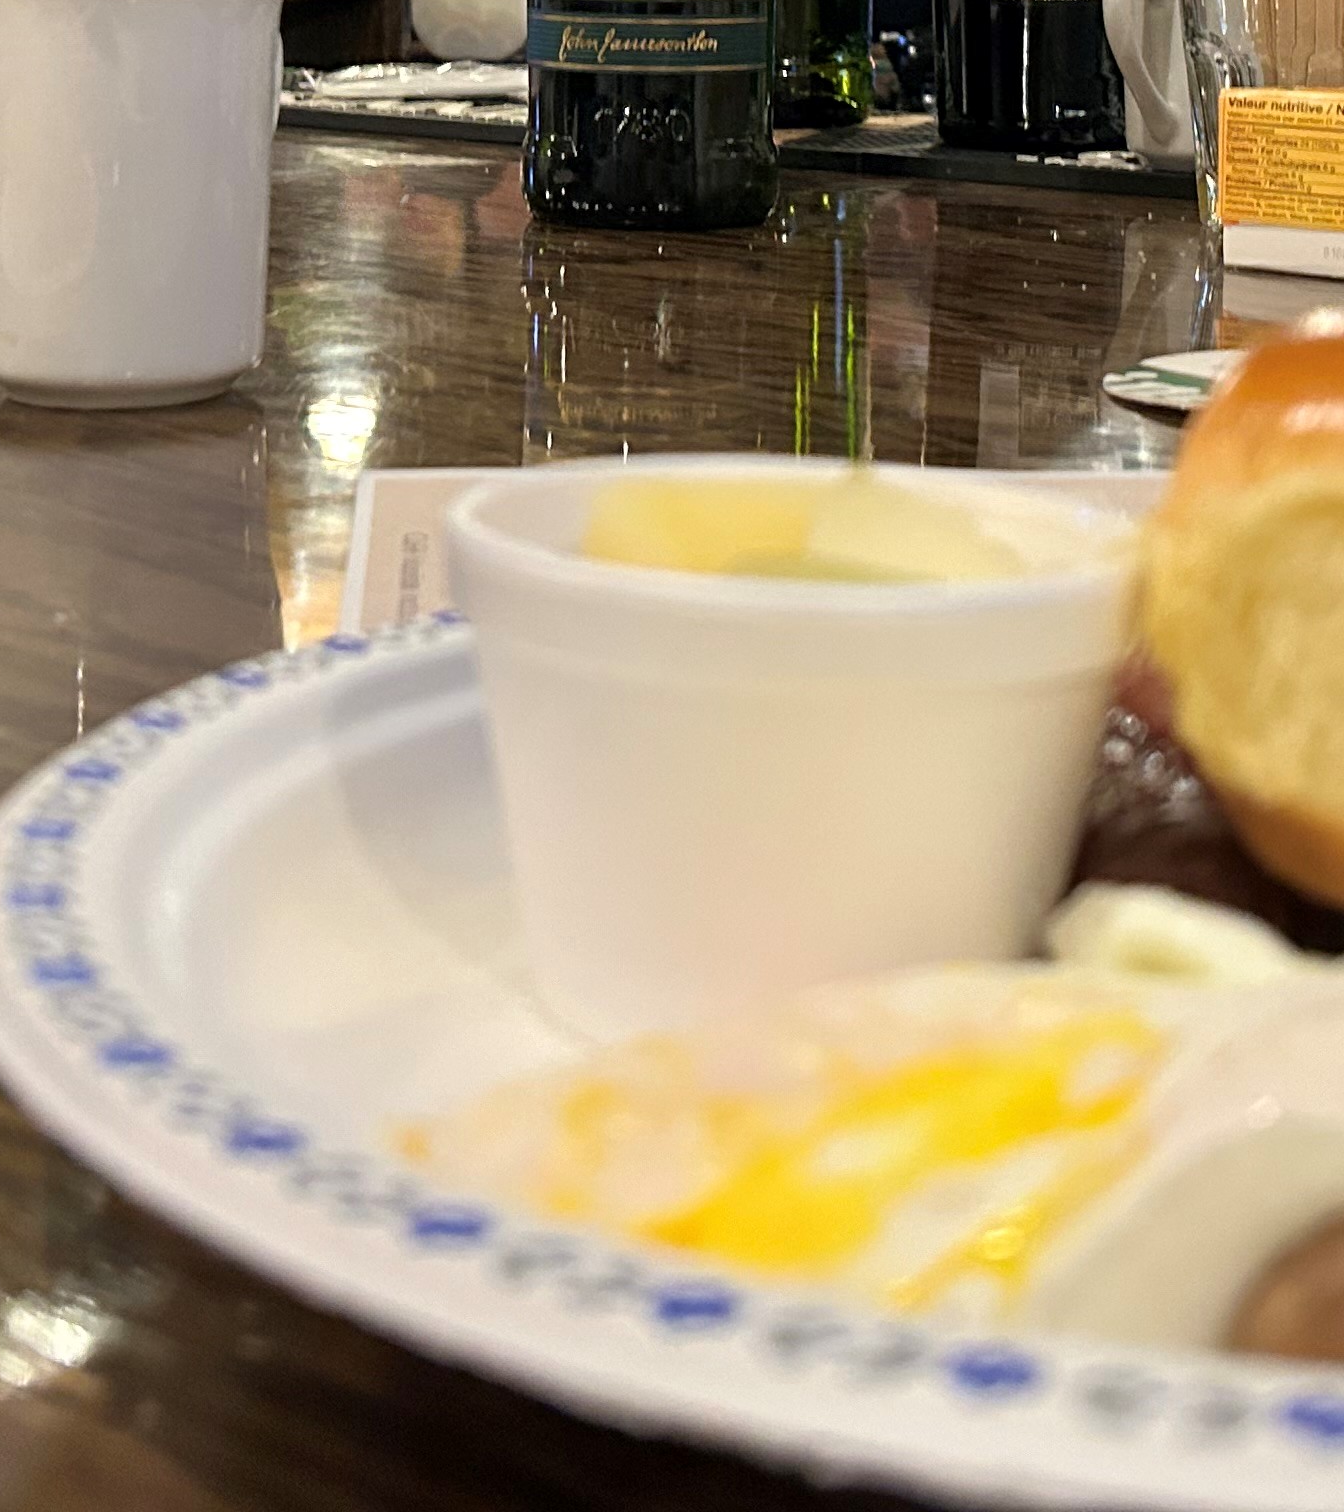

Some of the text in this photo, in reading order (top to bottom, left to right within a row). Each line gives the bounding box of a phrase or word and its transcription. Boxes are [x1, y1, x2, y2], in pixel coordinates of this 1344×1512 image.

[559, 25, 599, 63] John
[1228, 96, 1267, 109] Valeur
[1270, 99, 1324, 115] nutritive
